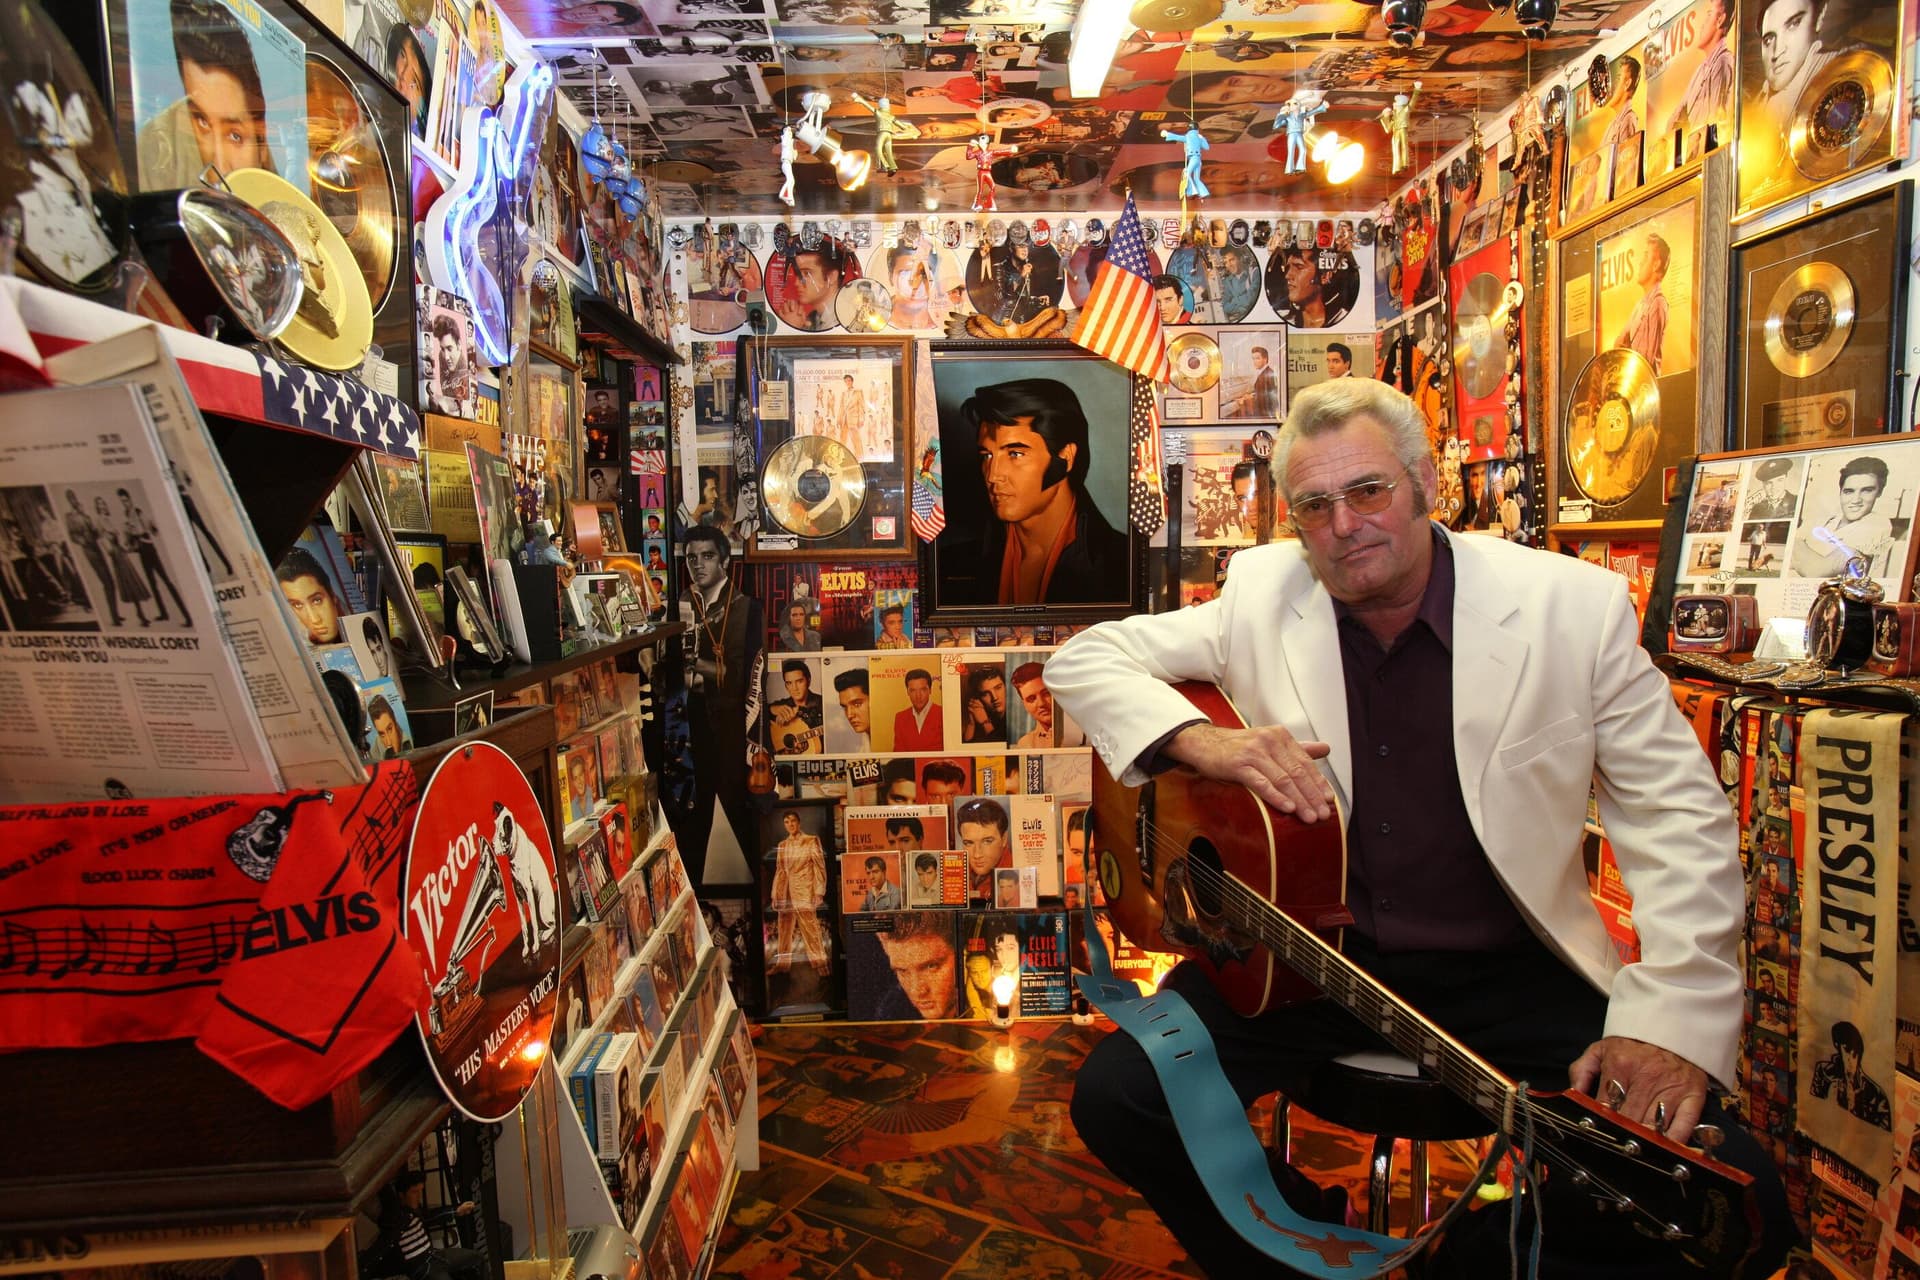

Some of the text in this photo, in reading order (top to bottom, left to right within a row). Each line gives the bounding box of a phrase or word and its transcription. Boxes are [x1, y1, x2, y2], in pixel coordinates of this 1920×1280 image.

[1663, 12, 1697, 64] LVIS
[1162, 217, 1181, 249] ELVIS
[1600, 247, 1634, 292] ELVIS
[1286, 359, 1317, 374] Elvis
[477, 395, 500, 427] ELVI
[820, 571, 866, 592] ELVIS
[875, 591, 912, 608] ELV
[8, 635, 200, 651] LIZABETH SCOTT WENDELL COREY
[34, 650, 81, 663] LOVING
[83, 651, 109, 664] YOU
[797, 760, 832, 774] Elvis
[852, 763, 880, 780] ELVIS
[29, 807, 90, 821] FALLING
[92, 807, 108, 817] IN
[111, 805, 149, 818] LOVE
[99, 799, 241, 857] IT'S NOW OR NEVER
[1022, 818, 1042, 830] ELVIS
[851, 833, 872, 845] ELVIS
[31, 839, 73, 866] LOVE
[1816, 734, 1876, 987] PRESLEY
[81, 866, 217, 885] GOOD LUCK CHARM
[410, 821, 478, 975] Victor
[240, 890, 381, 962] ELVIS
[1028, 936, 1057, 950] ELVIS
[1020, 952, 1067, 968] PRESLEY
[1118, 949, 1131, 958] FOR
[1113, 959, 1153, 970] EVERYONE
[454, 1050, 482, 1087] "HIS
[485, 997, 530, 1060] MASTER'S
[528, 964, 557, 1009] VOICE"
[101, 1230, 170, 1244] FINEST
[179, 1225, 235, 1239] IRISH
[243, 1219, 313, 1235] CREAM
